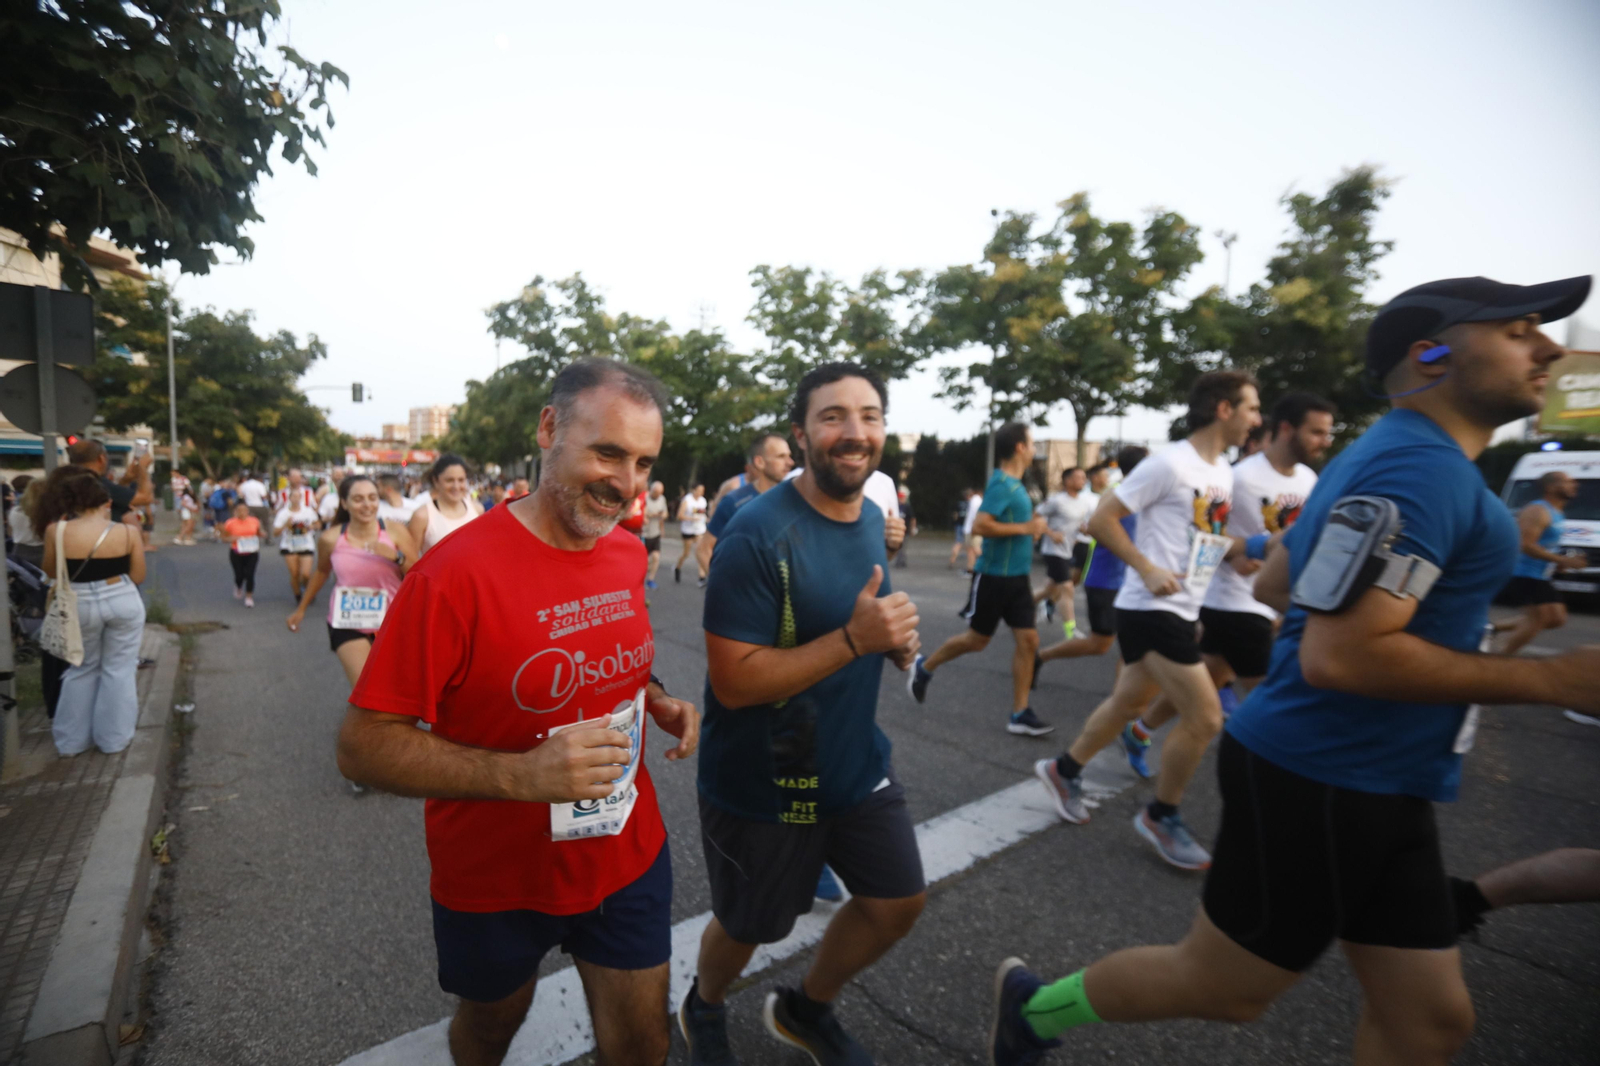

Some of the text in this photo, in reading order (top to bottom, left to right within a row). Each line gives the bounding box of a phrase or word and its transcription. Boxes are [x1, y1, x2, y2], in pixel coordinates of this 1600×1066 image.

[342, 594, 383, 610] 2014
[553, 600, 580, 617] SAN
[582, 589, 632, 609] SILVESTRE
[552, 601, 630, 630] solidaria
[548, 620, 590, 640] CIUDAD
[591, 616, 604, 627] DE
[772, 776, 819, 789] MADE
[792, 801, 817, 813] FIT
